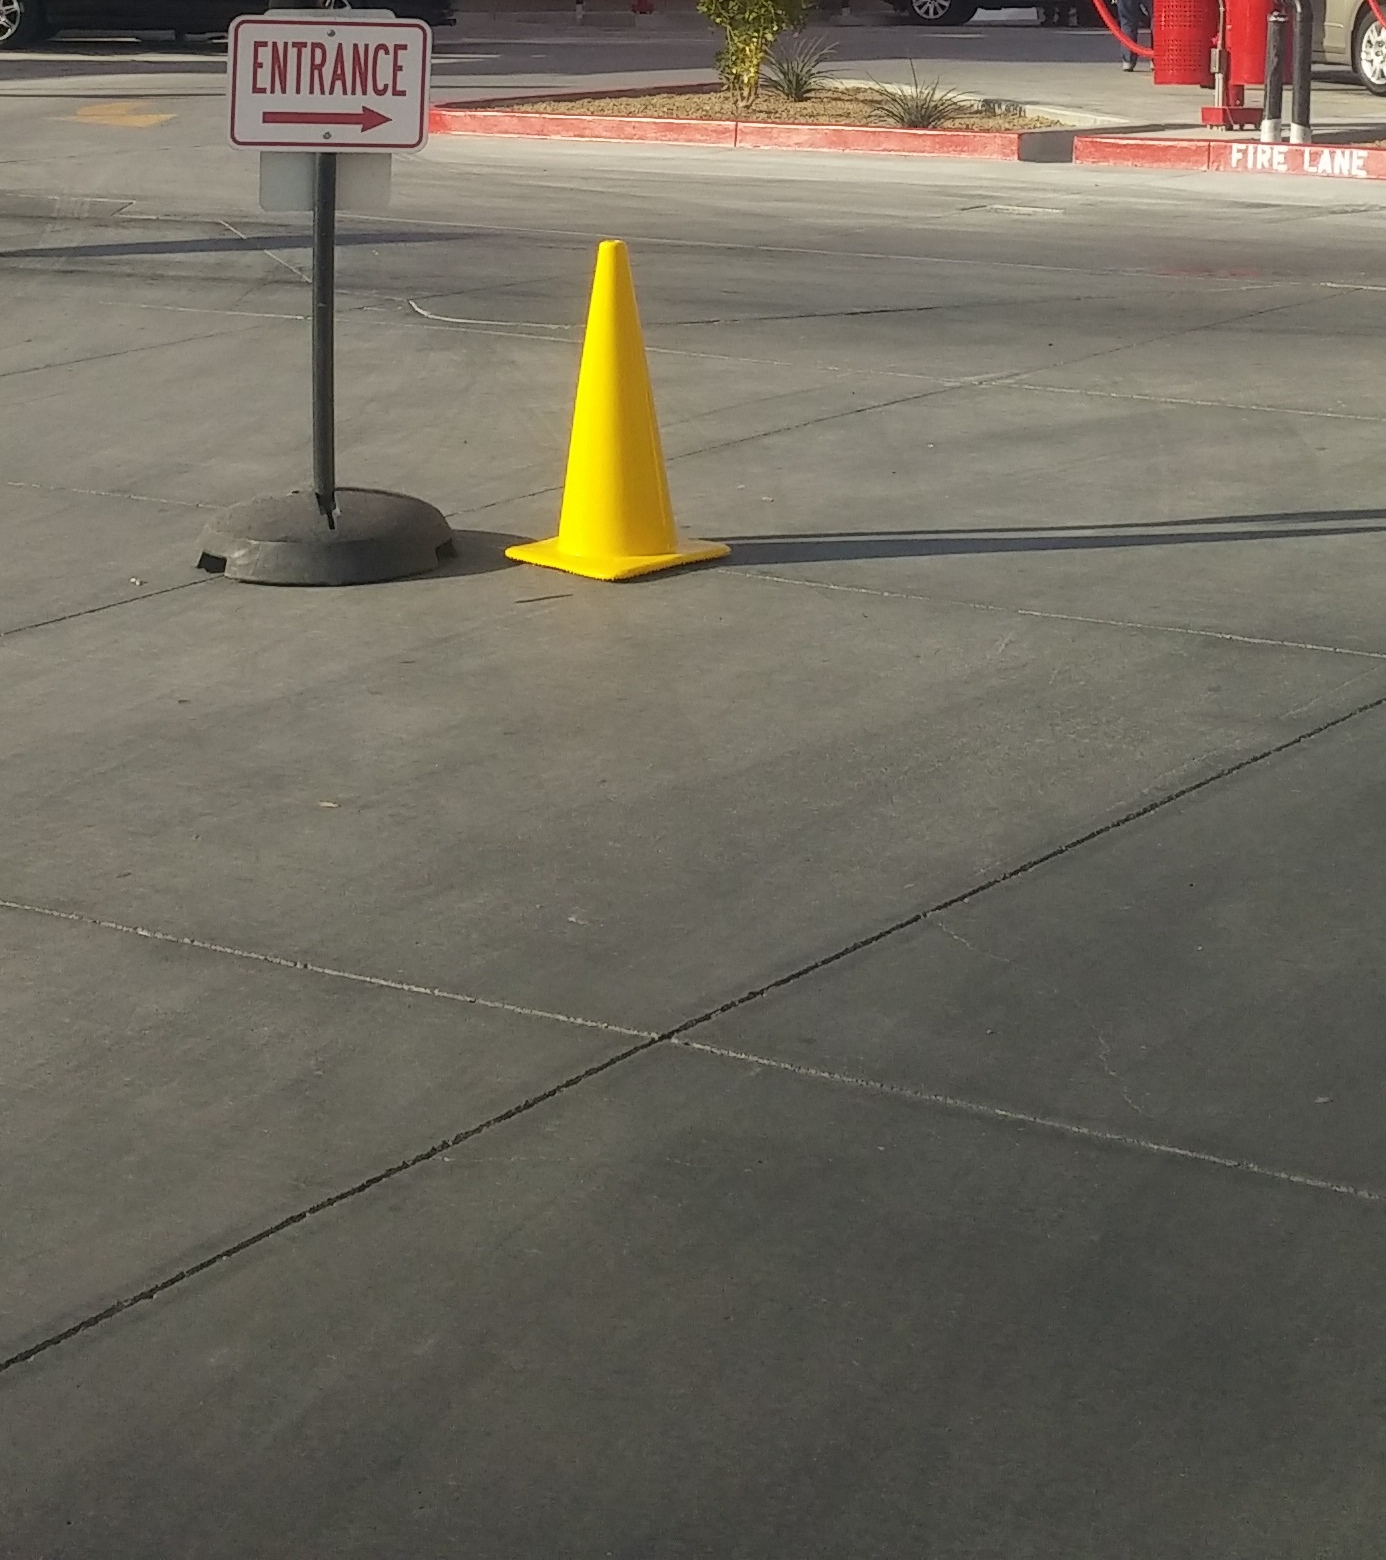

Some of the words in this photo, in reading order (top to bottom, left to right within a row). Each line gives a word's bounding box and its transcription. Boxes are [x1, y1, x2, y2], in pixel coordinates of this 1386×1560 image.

[252, 40, 408, 97] ENTRANCE
[1231, 143, 1289, 172] FIRE
[1303, 147, 1369, 178] LANE
